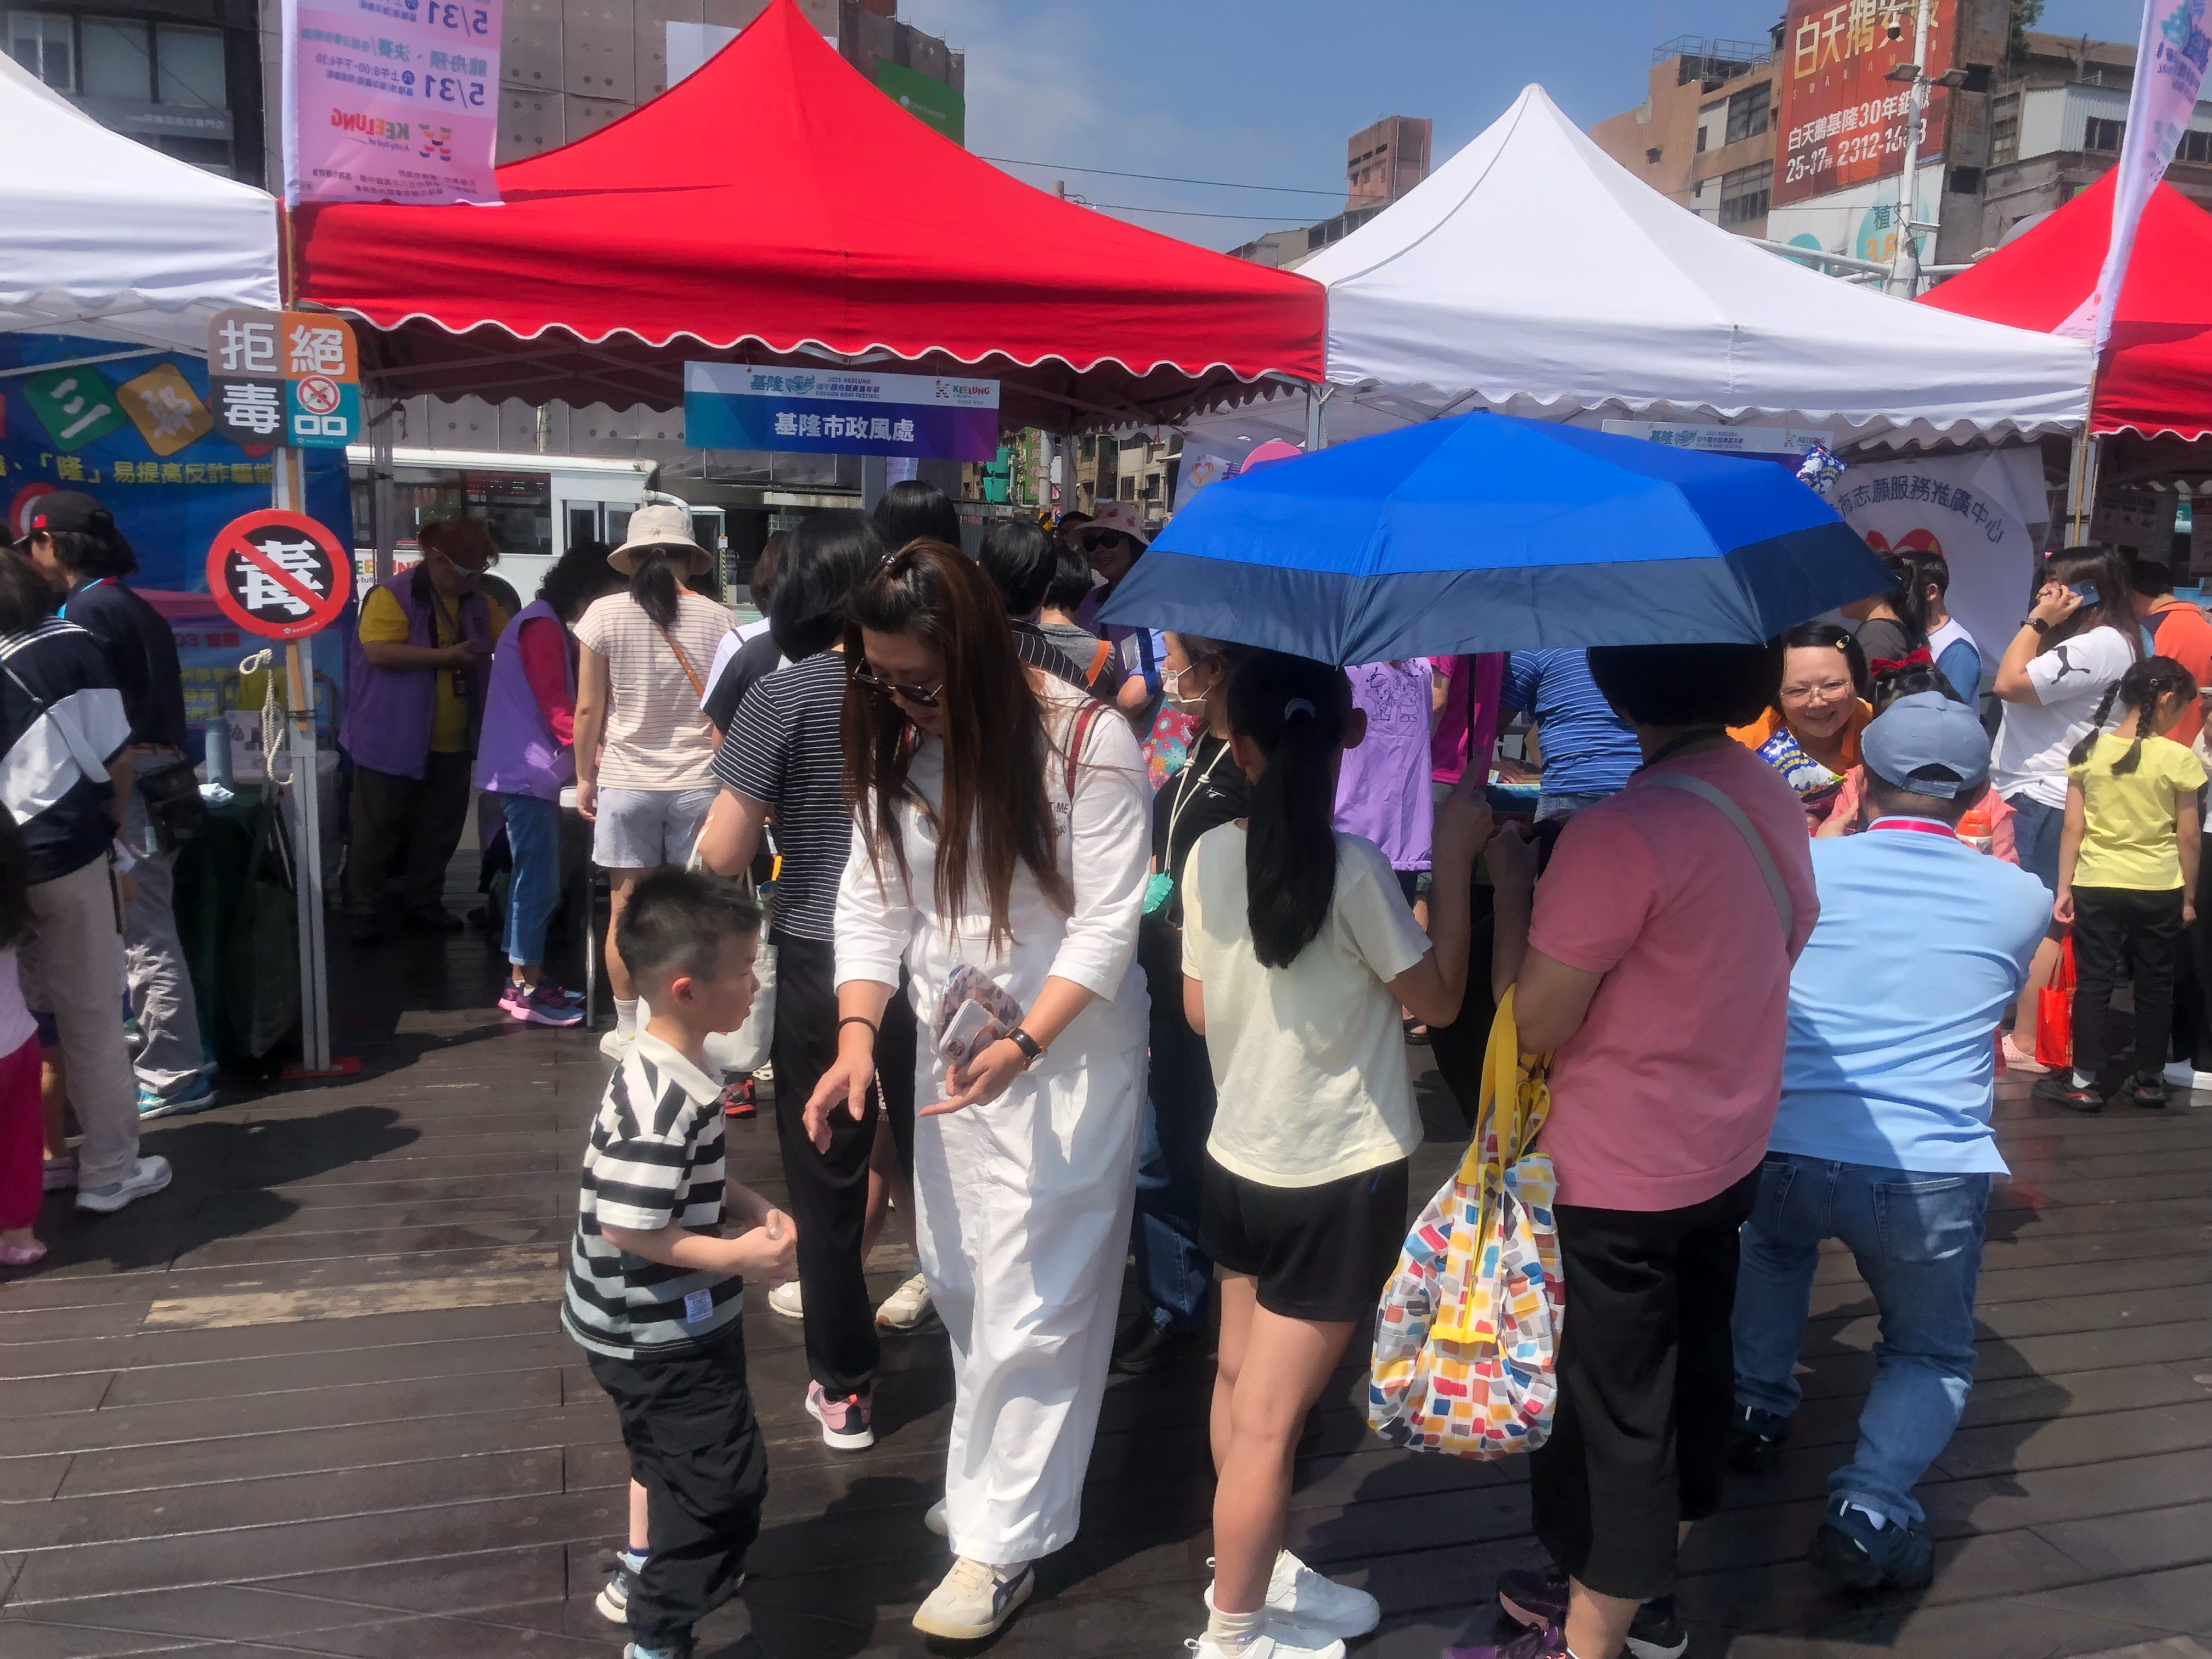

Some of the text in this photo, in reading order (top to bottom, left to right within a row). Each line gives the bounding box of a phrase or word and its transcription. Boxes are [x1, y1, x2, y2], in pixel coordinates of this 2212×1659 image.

[219, 319, 346, 375] 拒絕
[750, 374, 784, 392] 基隆
[953, 385, 990, 395] KEELUNG
[774, 411, 915, 442] 基隆市政風處
